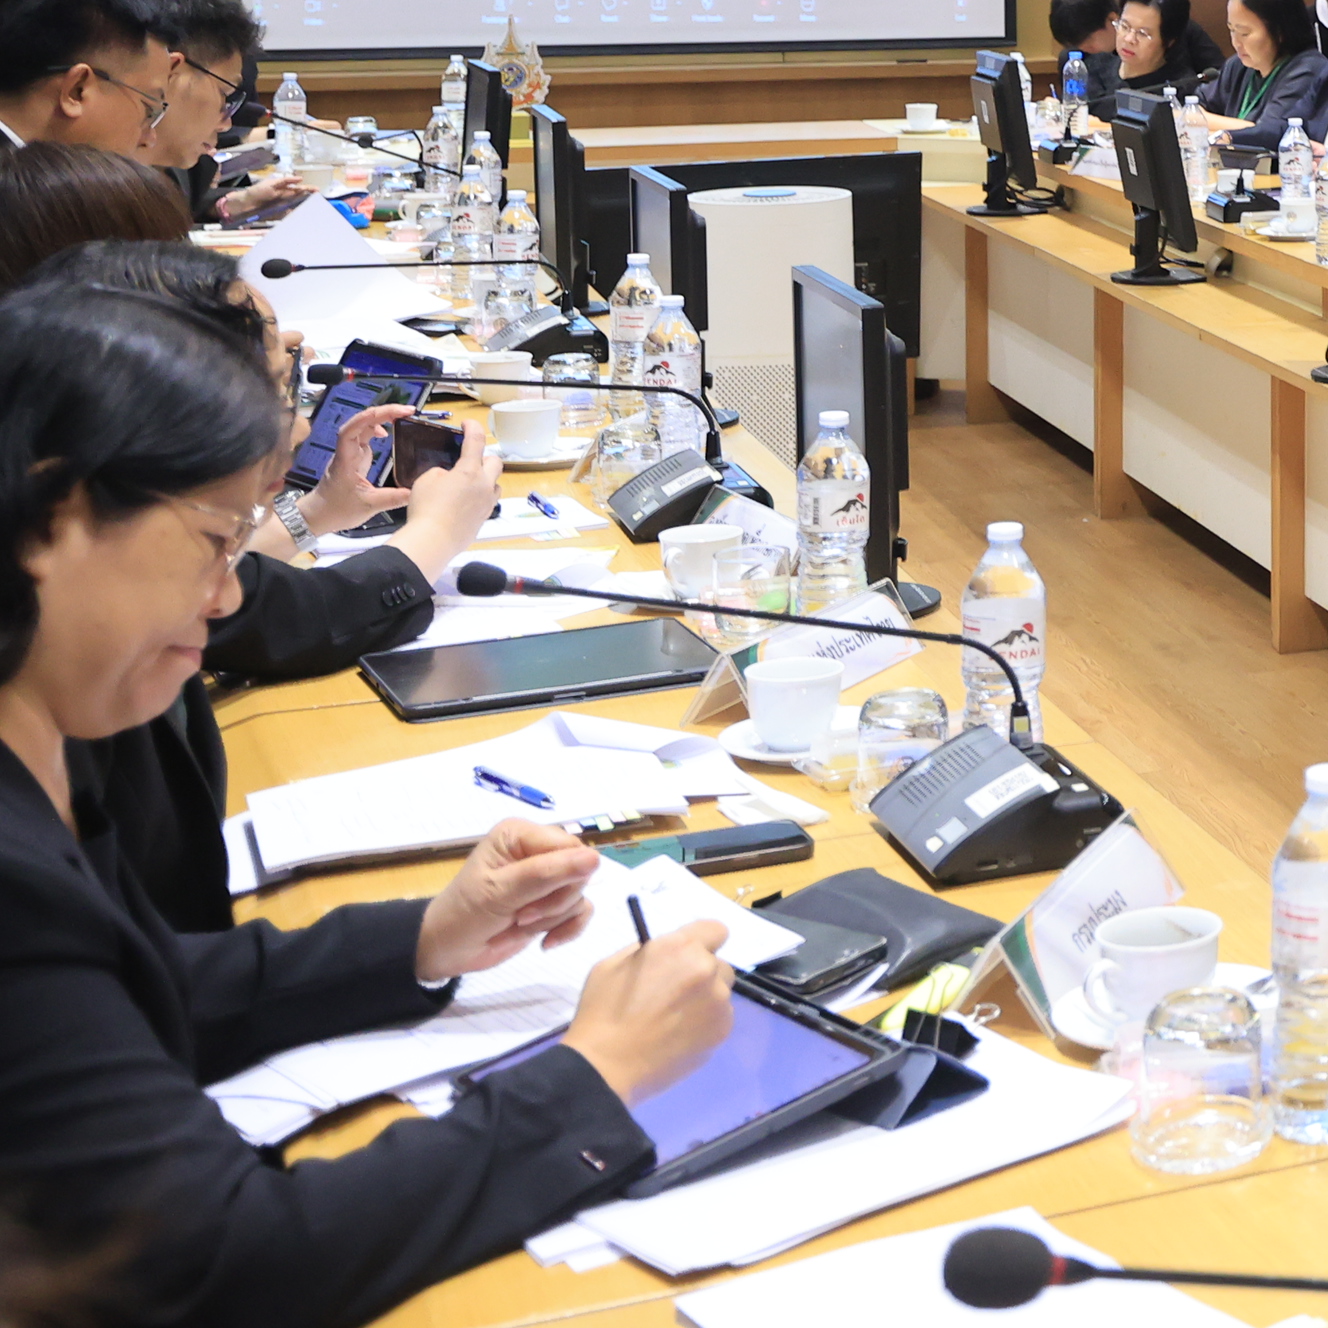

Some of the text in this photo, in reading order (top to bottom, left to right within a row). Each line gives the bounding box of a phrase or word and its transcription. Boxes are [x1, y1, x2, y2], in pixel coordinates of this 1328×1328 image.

[808, 615, 896, 660] ห่งประเทศไทย
[989, 647, 1041, 661] NDAI
